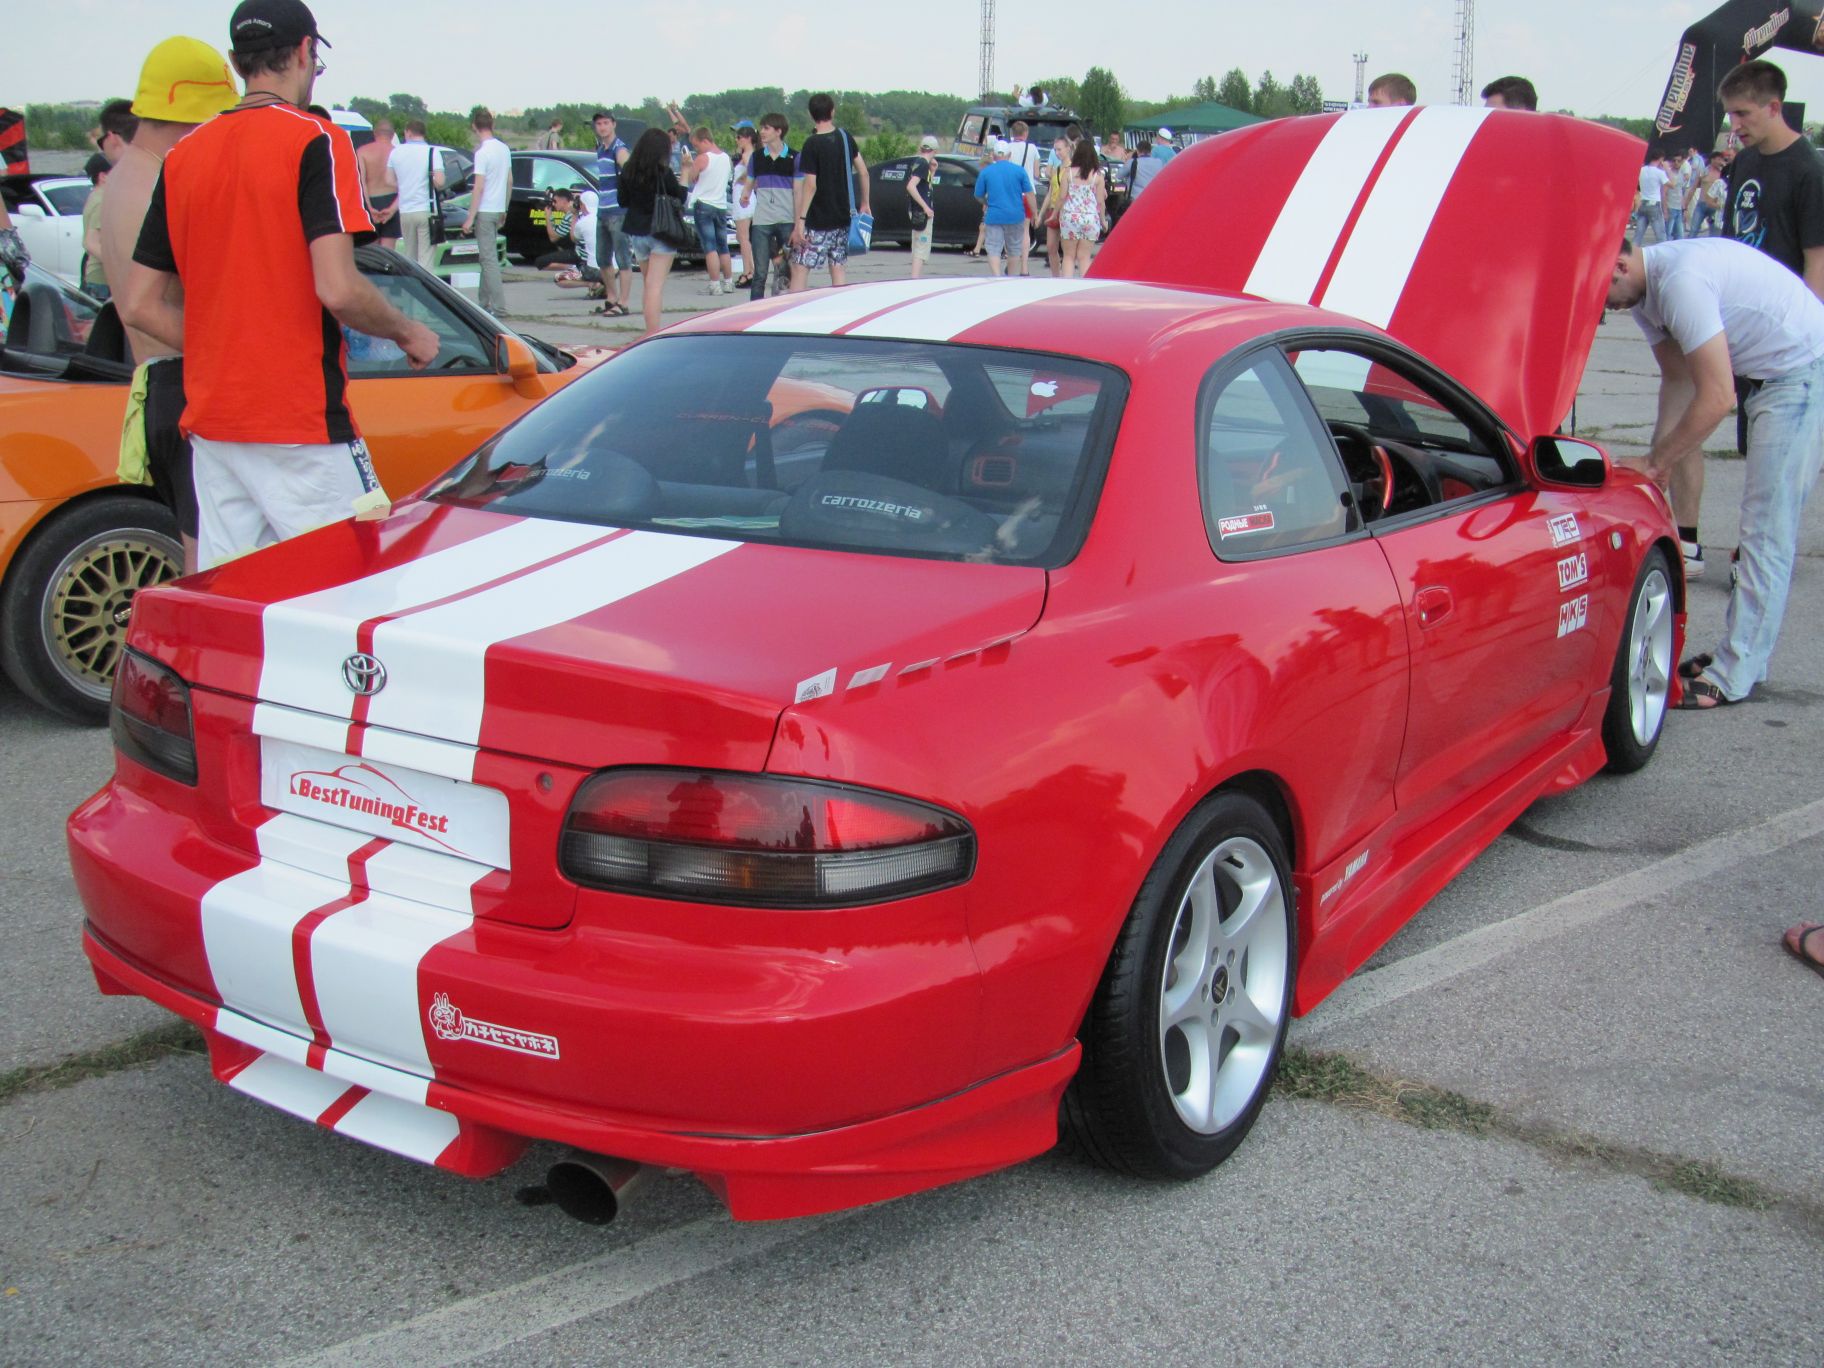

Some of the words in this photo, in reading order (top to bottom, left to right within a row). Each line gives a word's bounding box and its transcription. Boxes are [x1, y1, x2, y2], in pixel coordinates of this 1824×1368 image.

[822, 495, 922, 519] carrozzeria
[1559, 556, 1587, 584] TOM'S
[1560, 598, 1587, 626] HKS
[300, 778, 449, 833] BestTuningFest
